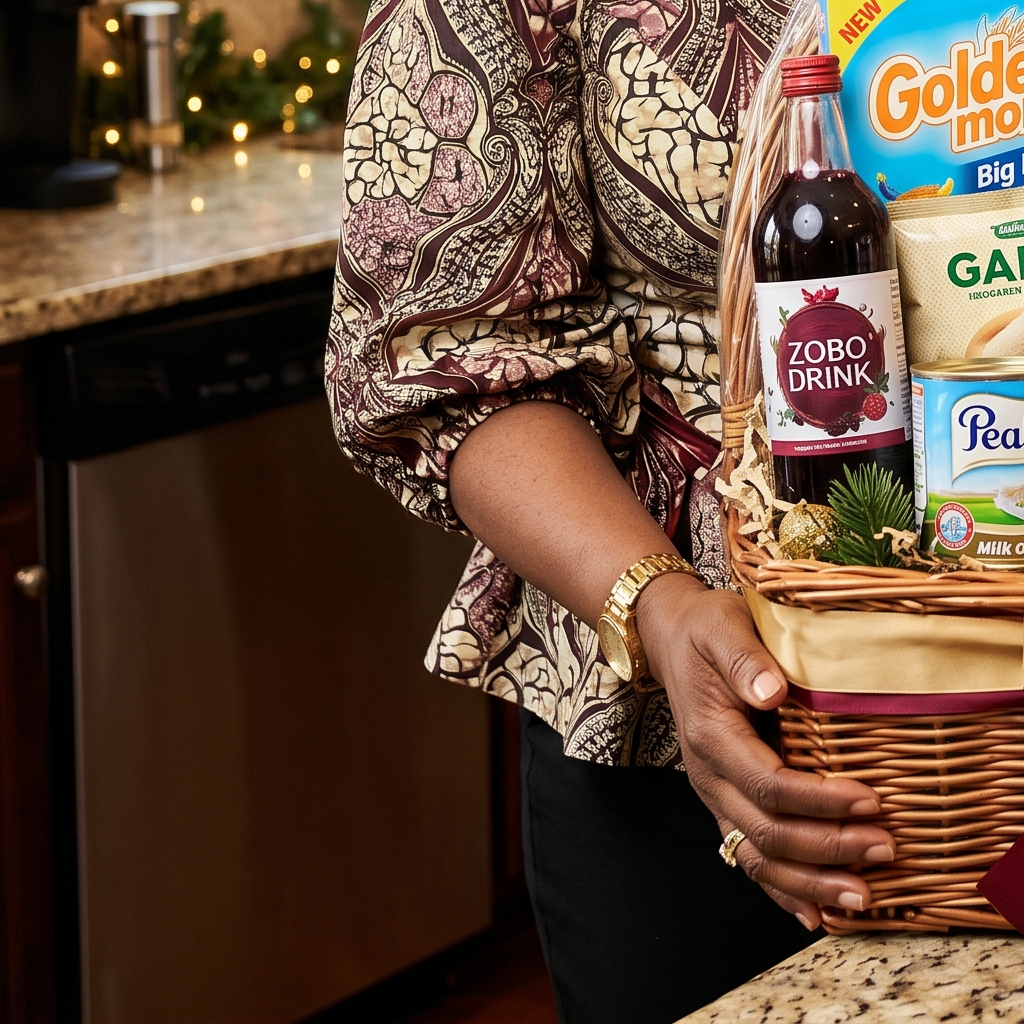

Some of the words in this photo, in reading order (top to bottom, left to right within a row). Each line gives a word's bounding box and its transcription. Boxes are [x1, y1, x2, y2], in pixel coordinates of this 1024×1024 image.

[977, 161, 1015, 189] Big
[787, 335, 867, 366] ZOBO
[788, 360, 875, 393] DRINK
